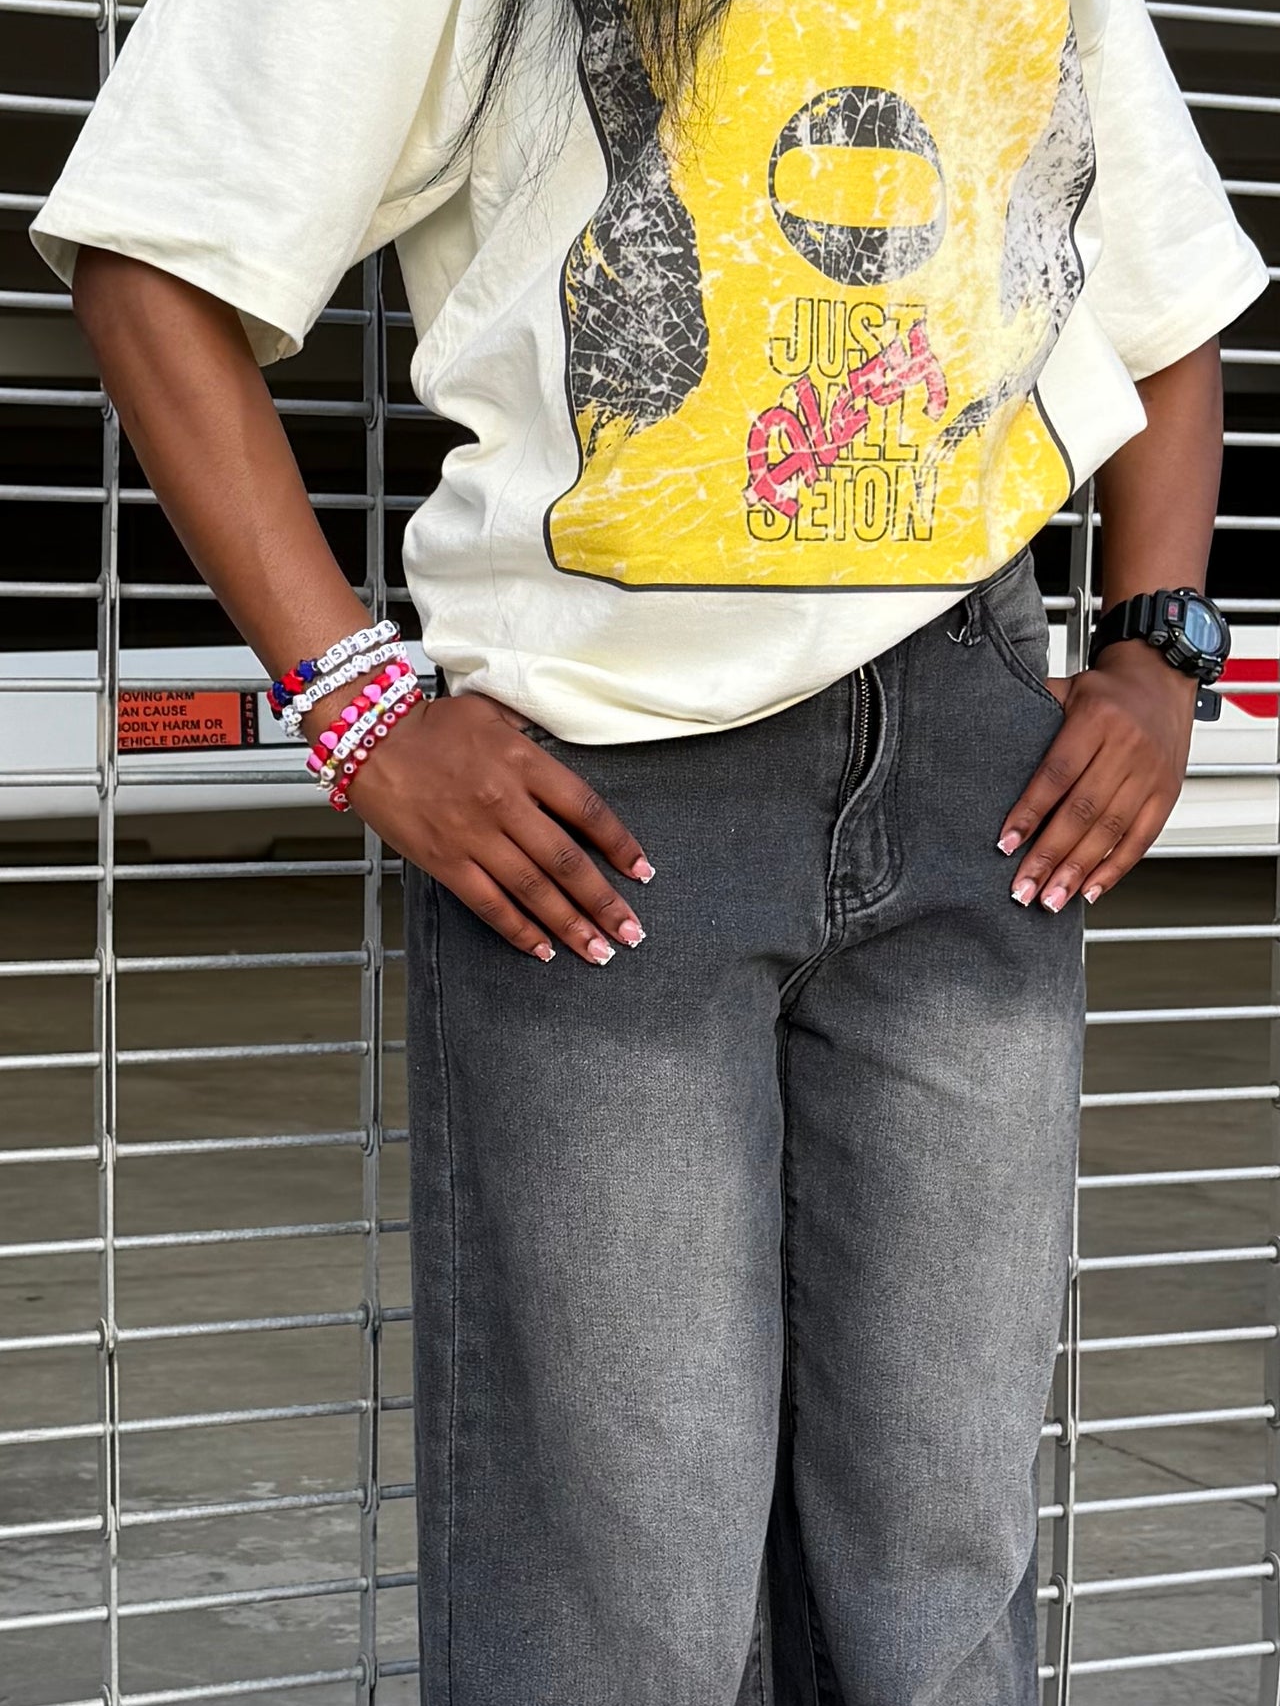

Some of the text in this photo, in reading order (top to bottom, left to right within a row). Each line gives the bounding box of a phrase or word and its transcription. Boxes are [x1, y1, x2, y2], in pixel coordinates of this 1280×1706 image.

[770, 297, 927, 377] JUST
[746, 464, 938, 542] SETON
[118, 691, 195, 703] OVING ARM
[118, 705, 187, 717] AN CAUSE
[118, 718, 224, 733] ODILY HARM OR
